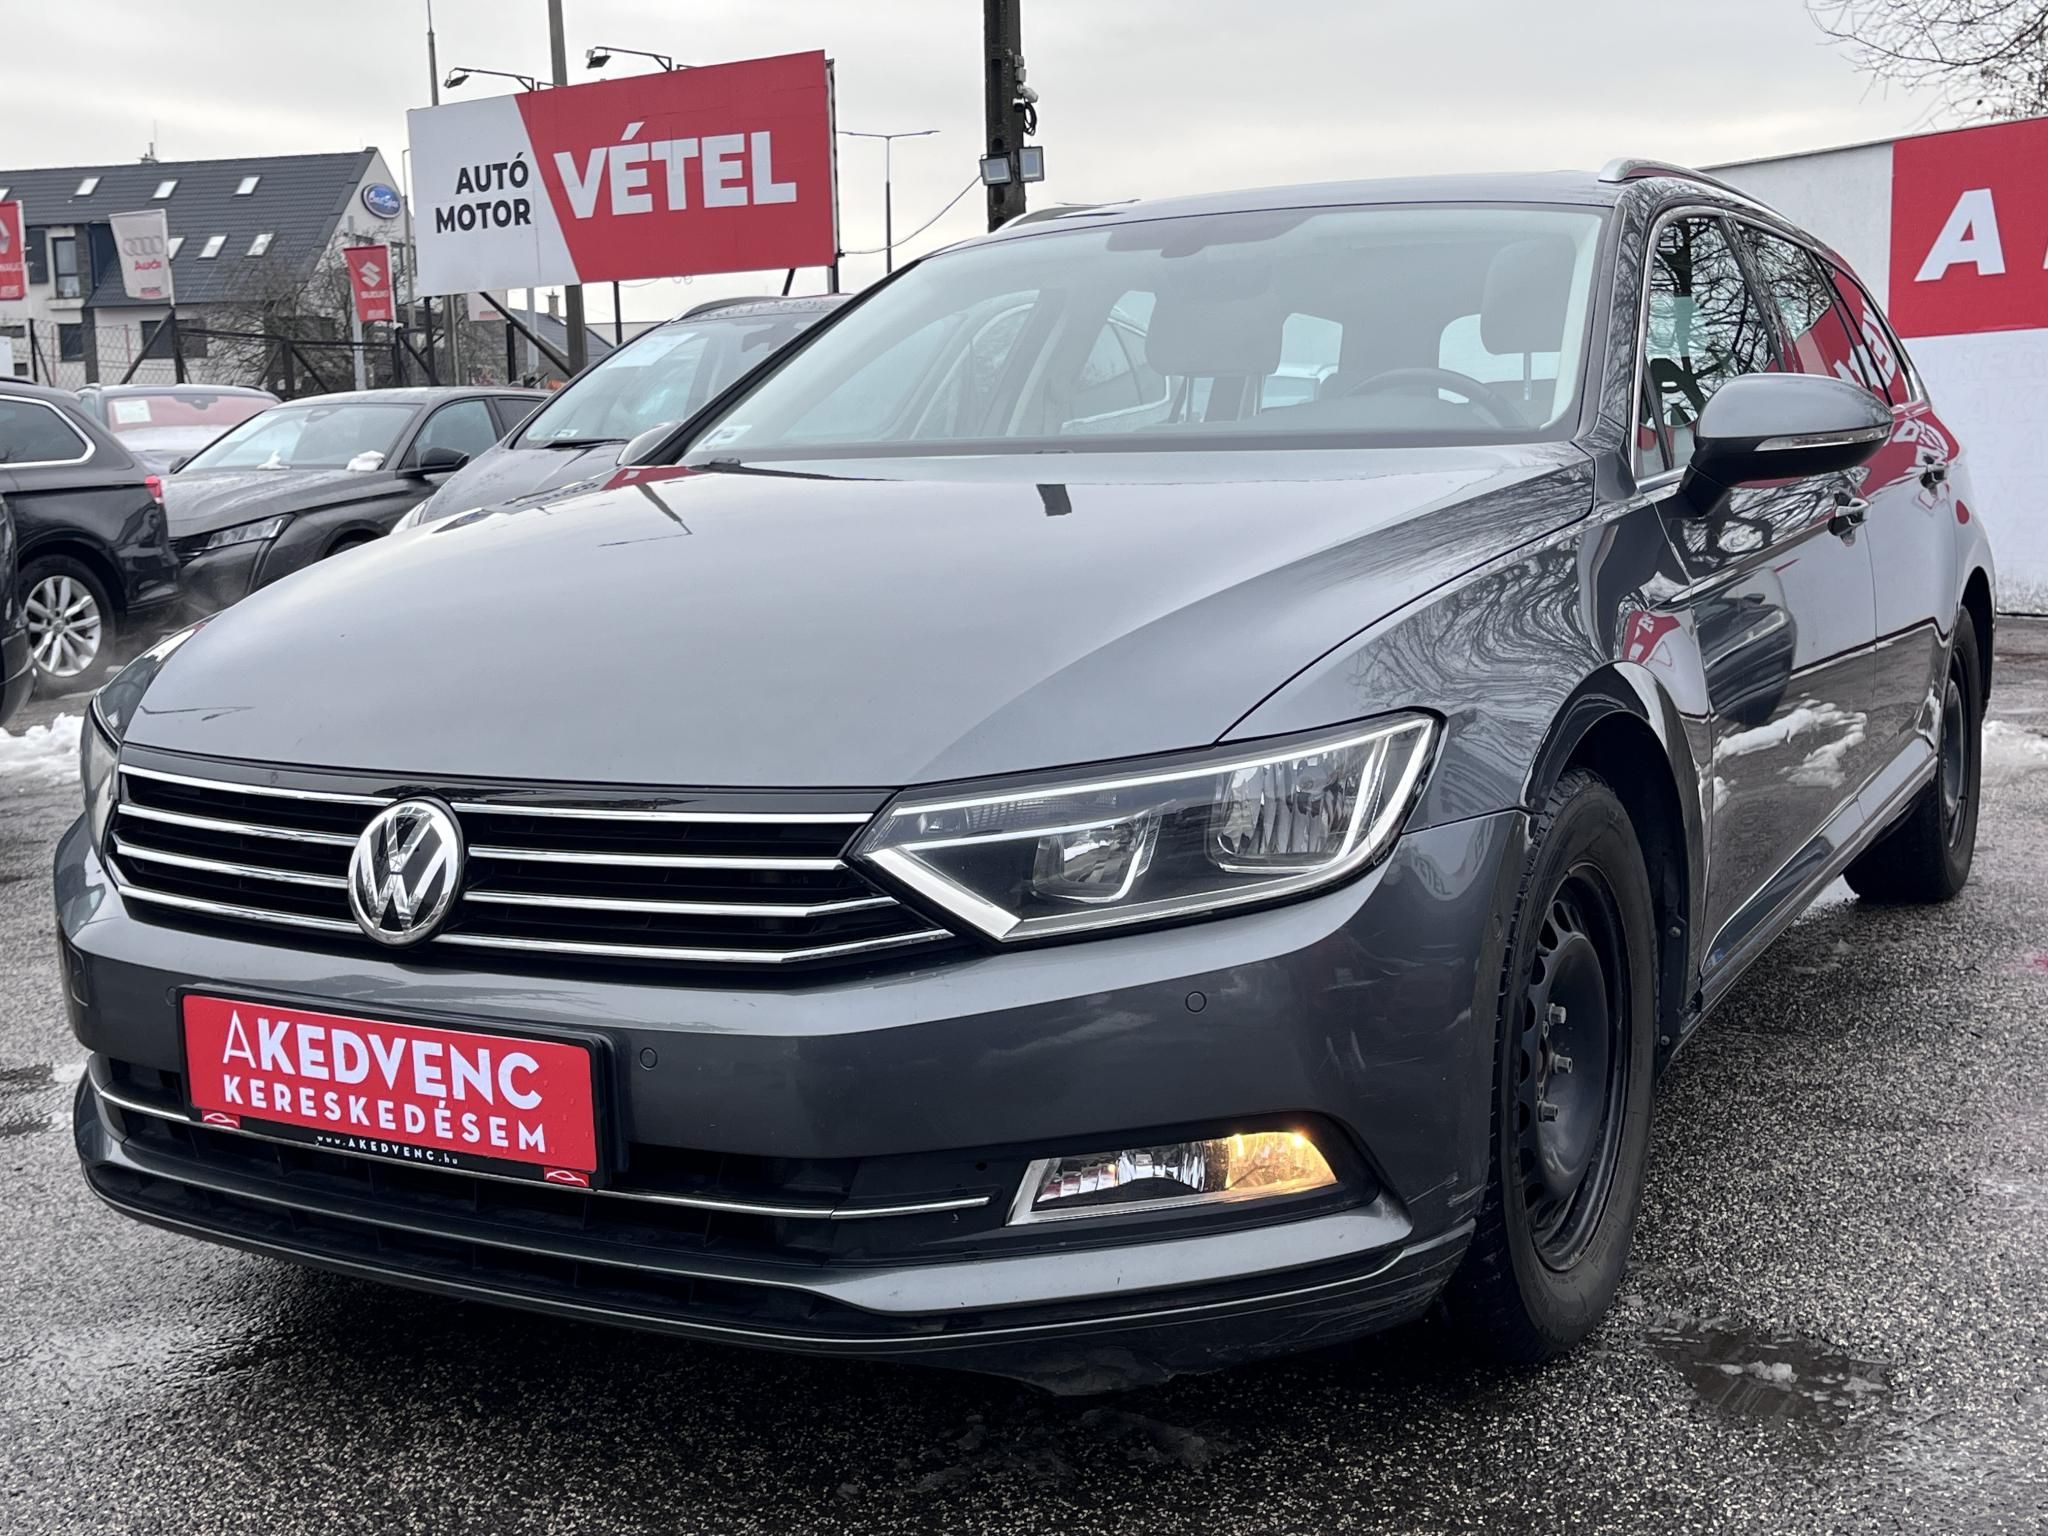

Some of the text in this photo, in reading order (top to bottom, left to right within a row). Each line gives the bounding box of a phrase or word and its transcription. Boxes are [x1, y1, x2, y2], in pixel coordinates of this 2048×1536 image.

[456, 152, 529, 194] AUTÓ
[553, 121, 797, 219] VÉTEL
[435, 198, 531, 234] MOTOR
[222, 1009, 543, 1110] AKEDVENC
[223, 1073, 546, 1153] KERESKEDÉSEM
